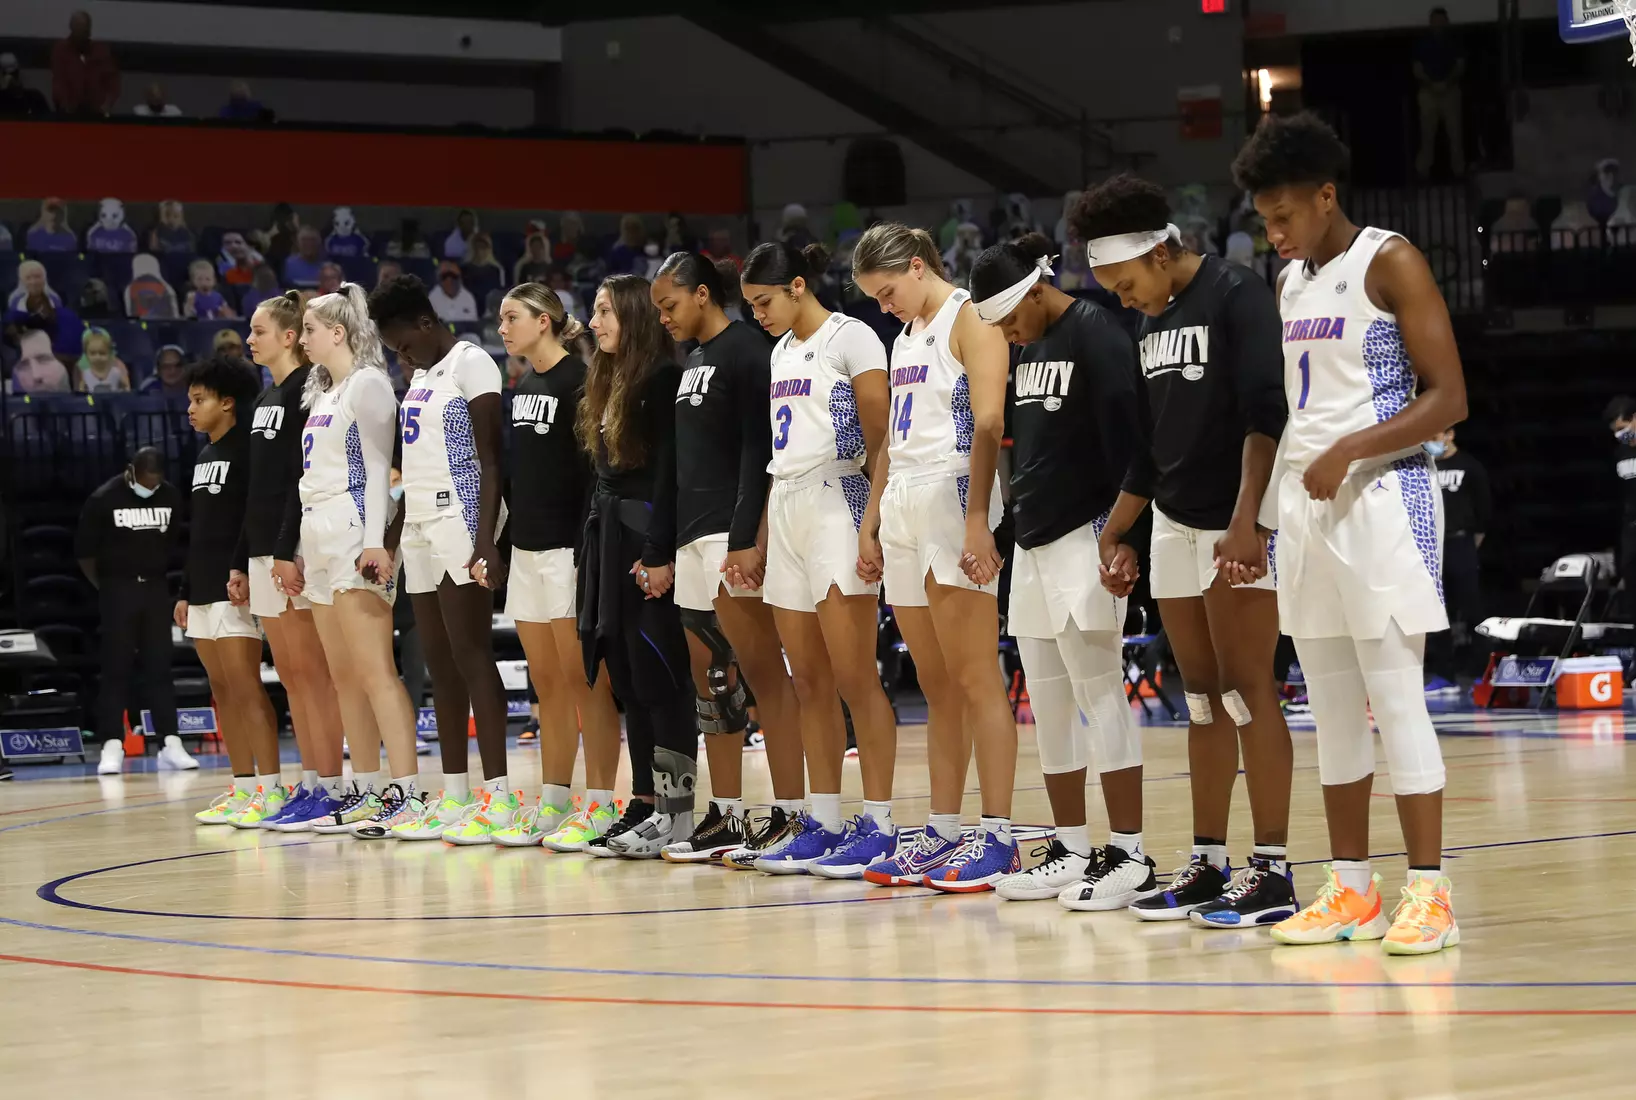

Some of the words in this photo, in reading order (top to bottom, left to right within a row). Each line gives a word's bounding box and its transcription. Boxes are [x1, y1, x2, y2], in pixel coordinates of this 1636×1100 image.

[1583, 6, 1614, 21] SPALDING
[891, 364, 929, 388] LORIDA
[1297, 350, 1310, 410] 1
[770, 378, 812, 400] LORIDA
[773, 404, 792, 450] 3
[892, 391, 913, 443] 14
[303, 432, 315, 469] 2
[113, 507, 172, 529] EQUALITY
[1590, 673, 1612, 702] G
[180, 712, 207, 725] Star
[25, 734, 71, 751] VyStar
